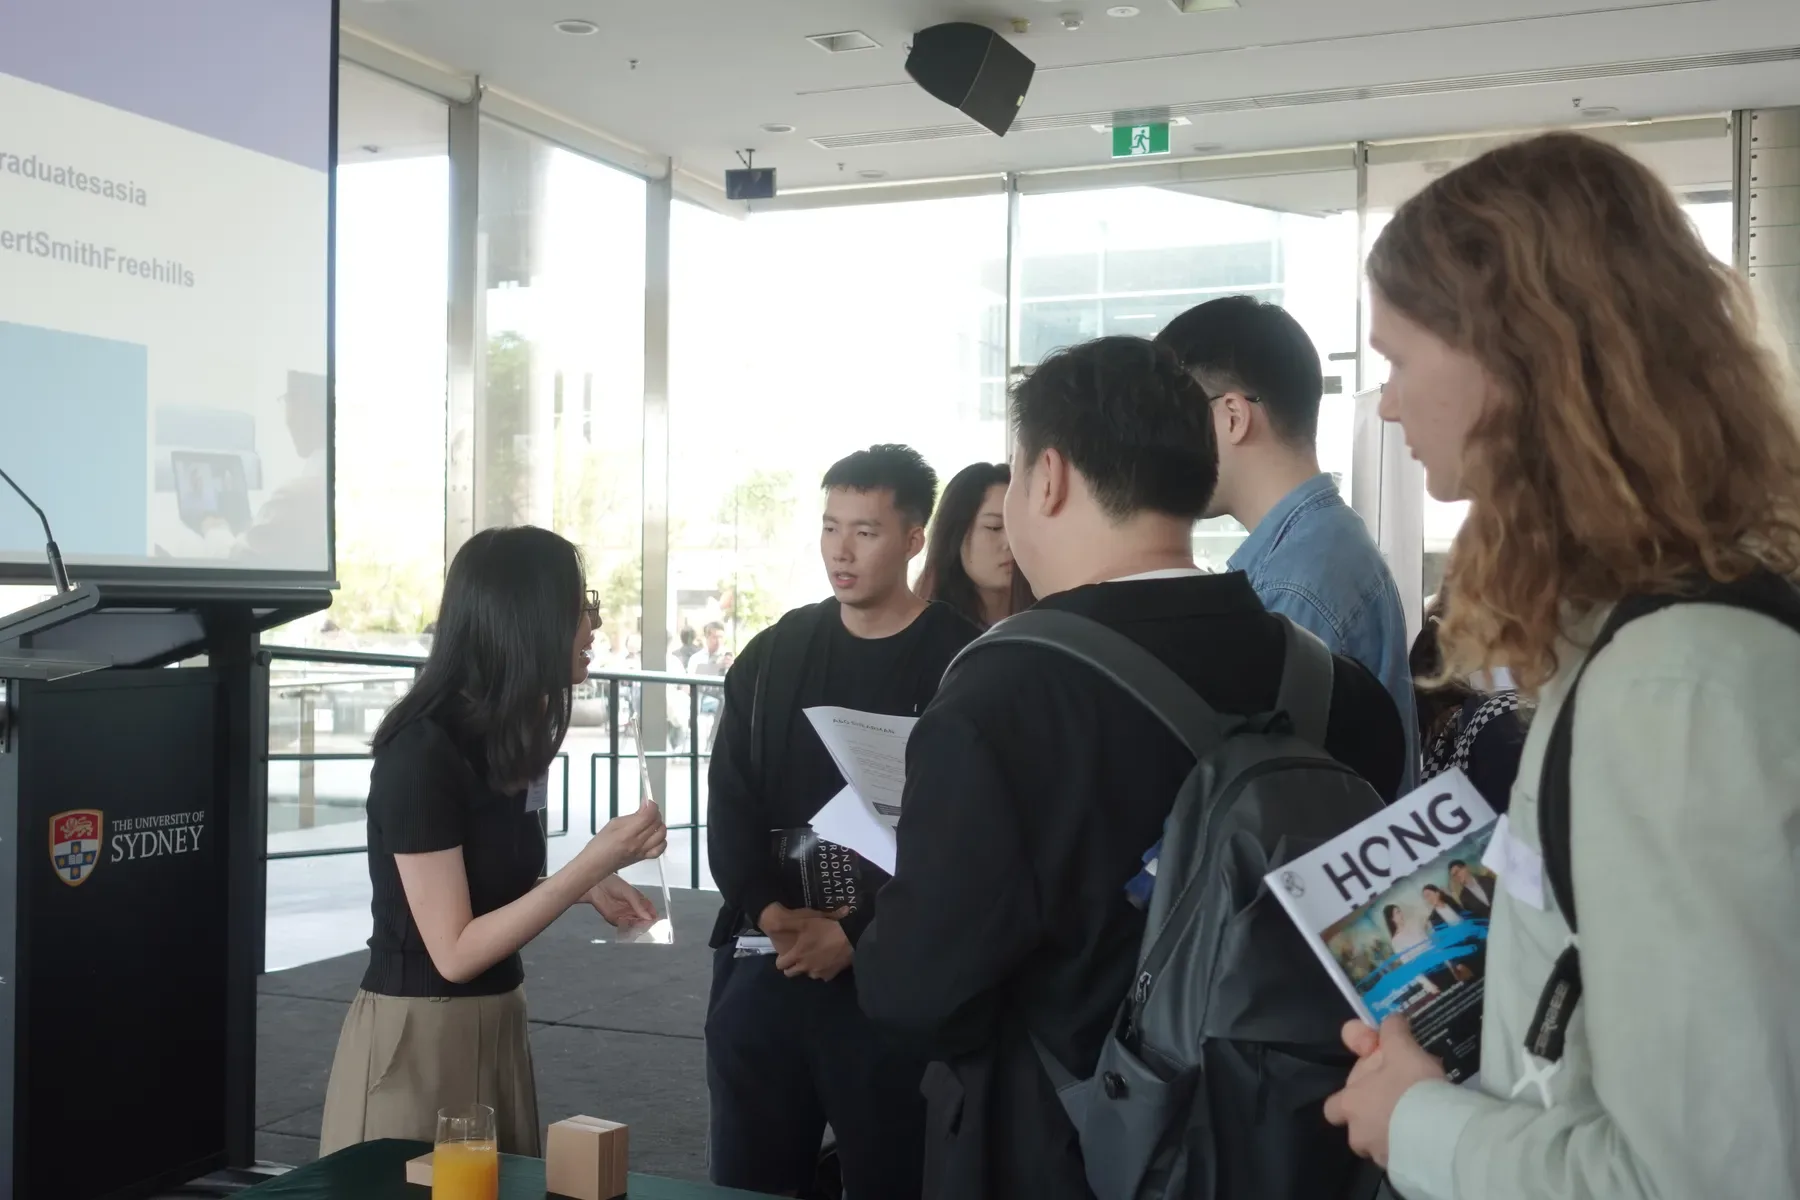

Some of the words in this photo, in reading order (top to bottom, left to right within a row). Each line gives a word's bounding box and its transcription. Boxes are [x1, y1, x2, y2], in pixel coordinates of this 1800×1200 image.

[0, 230, 195, 288] ertSmithFreehills
[111, 825, 204, 863] SYDNEY
[112, 819, 133, 832] THE
[135, 812, 191, 829] UNIVERSITY
[192, 811, 205, 822] OF
[1322, 793, 1472, 902] HONG
